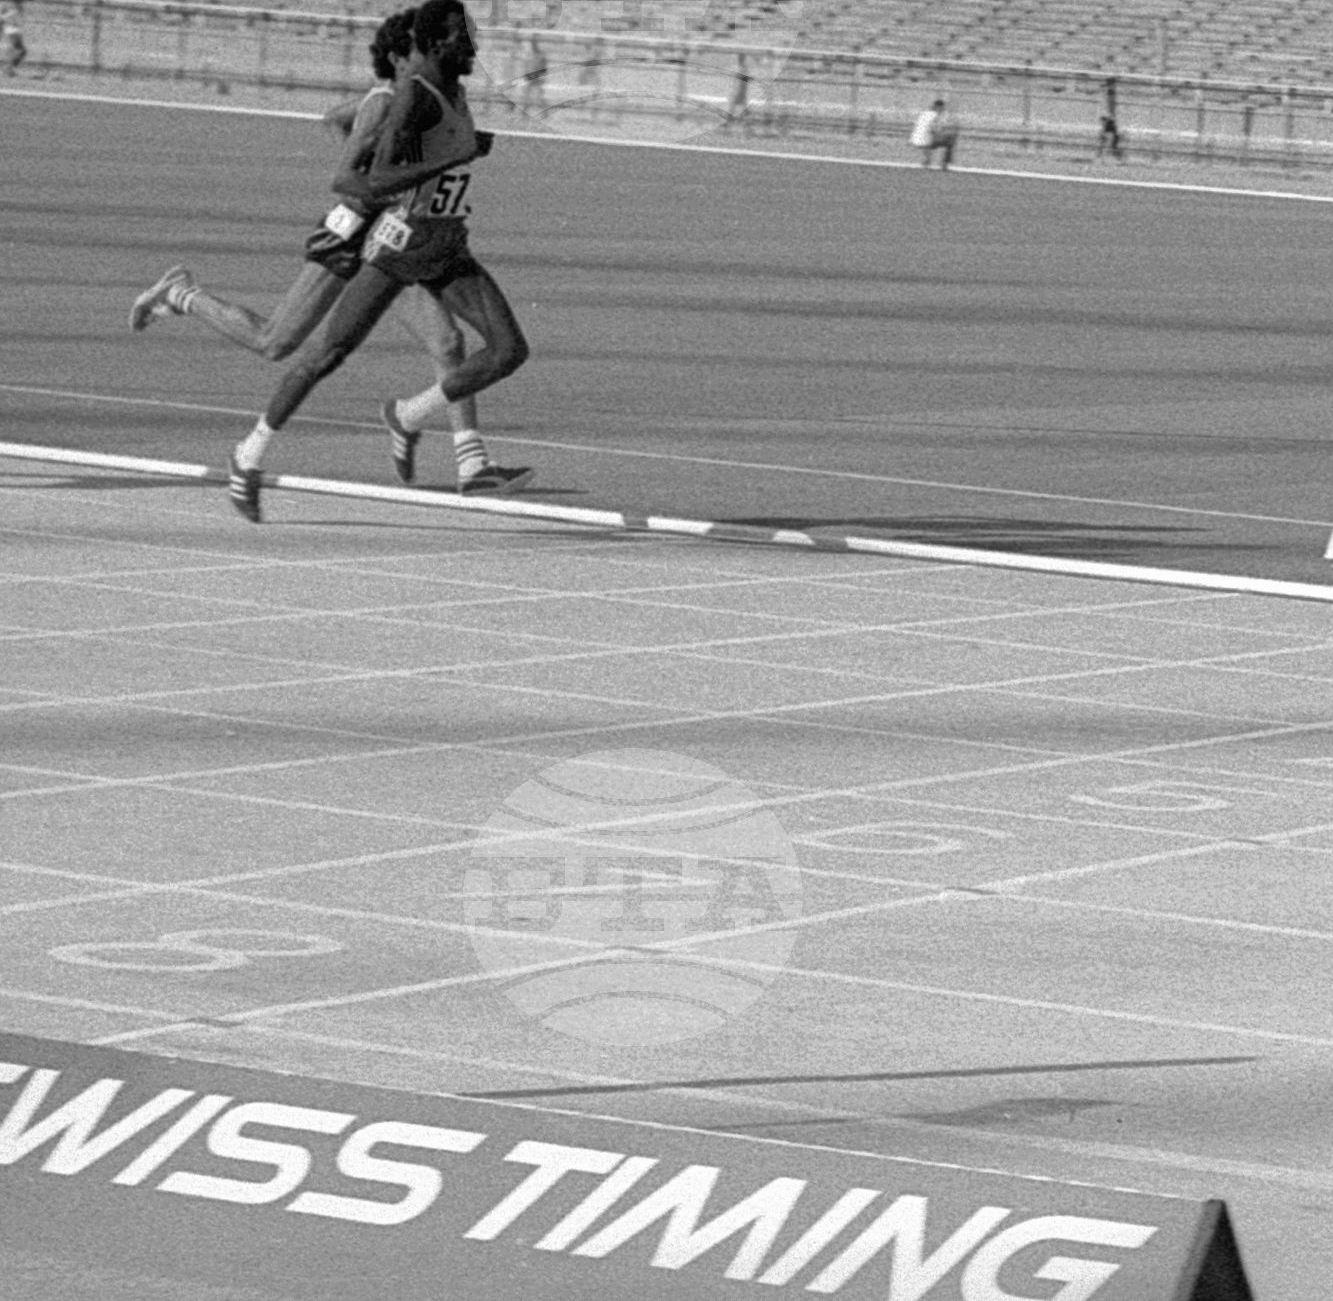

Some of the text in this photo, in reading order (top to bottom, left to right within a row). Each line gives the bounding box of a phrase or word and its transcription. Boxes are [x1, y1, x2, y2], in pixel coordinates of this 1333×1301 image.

[430, 173, 472, 215] 57
[1067, 781, 1292, 812] 5
[790, 821, 1016, 855] 6
[47, 928, 343, 972] 8
[0, 1062, 1159, 1301] WISS TIMING
